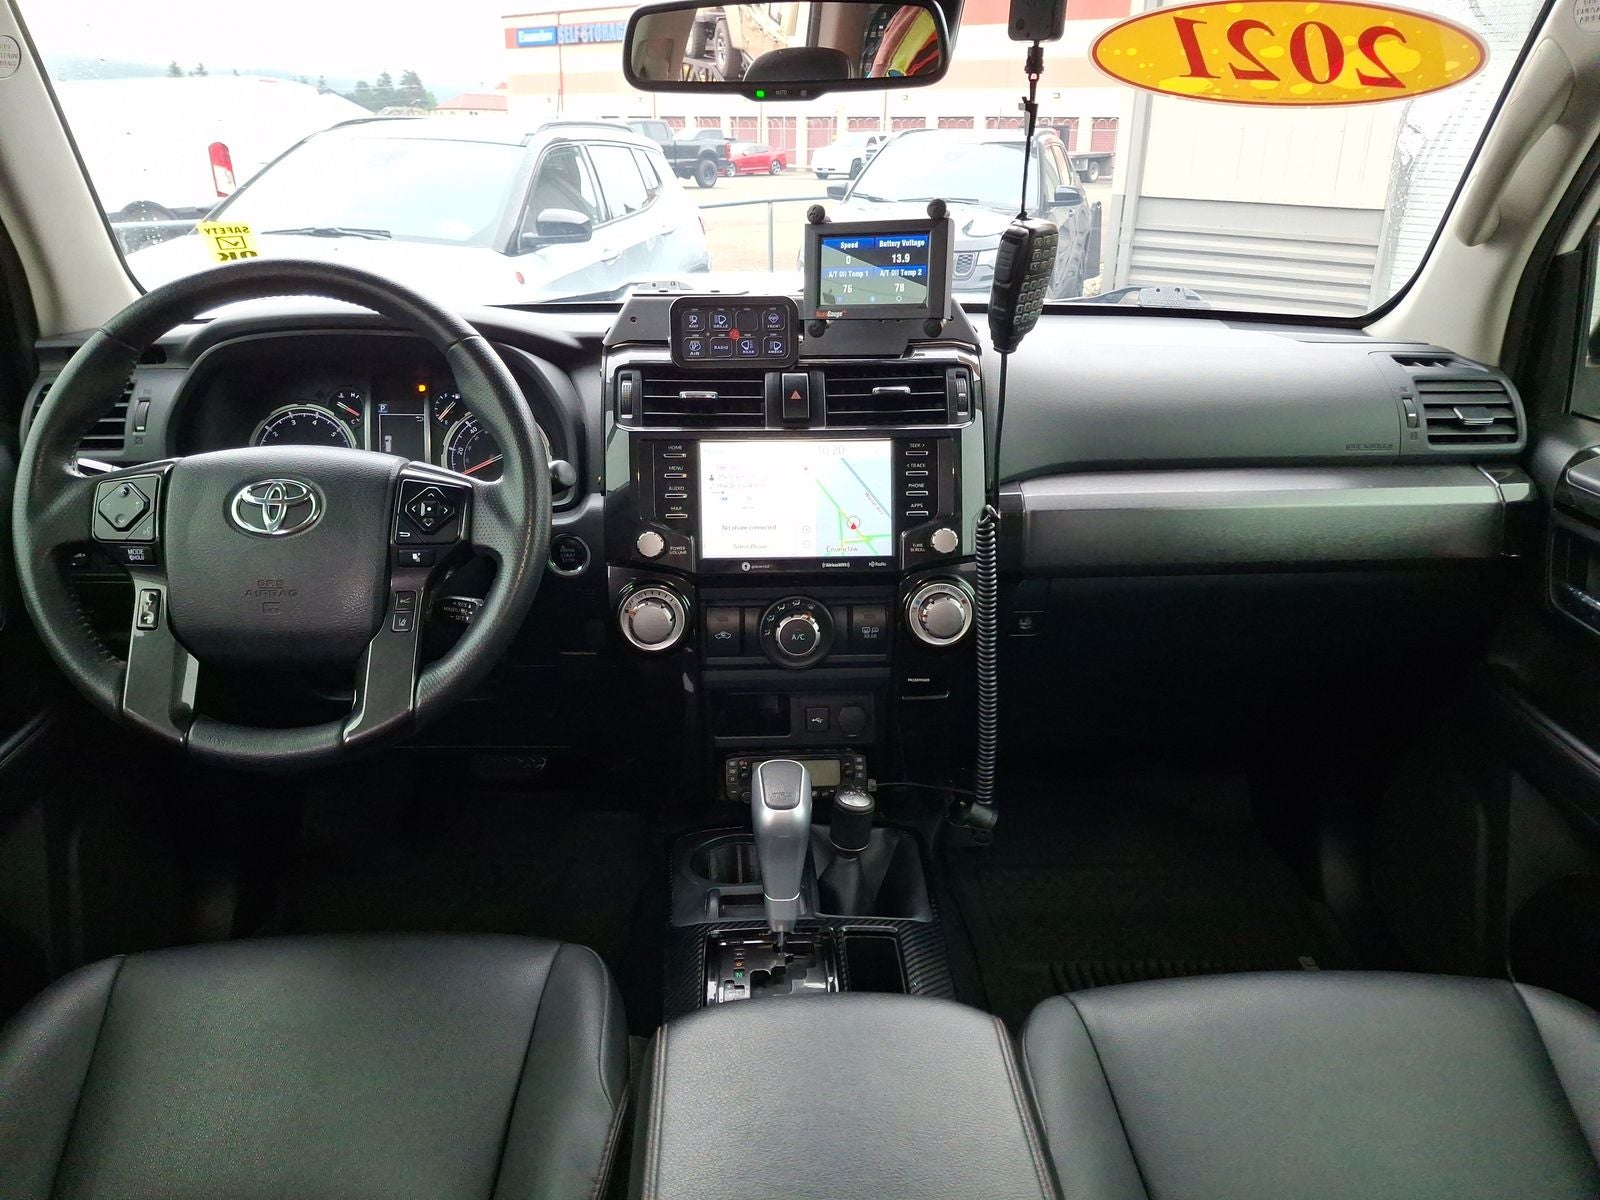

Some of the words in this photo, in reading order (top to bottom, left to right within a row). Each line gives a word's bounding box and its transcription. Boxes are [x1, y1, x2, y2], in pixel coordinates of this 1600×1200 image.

[840, 241, 859, 249] Speed
[879, 240, 899, 248] Battery
[902, 239, 925, 247] Voltage
[845, 255, 851, 265] 0
[891, 253, 911, 263] 13.9
[848, 270, 864, 279] Temp
[901, 269, 916, 277] Temp
[917, 268, 922, 276] 2
[842, 284, 853, 293] 76
[894, 283, 905, 292] 78
[469, 426, 478, 434] 40
[457, 446, 464, 456] 20
[826, 545, 859, 553] Enumclaw
